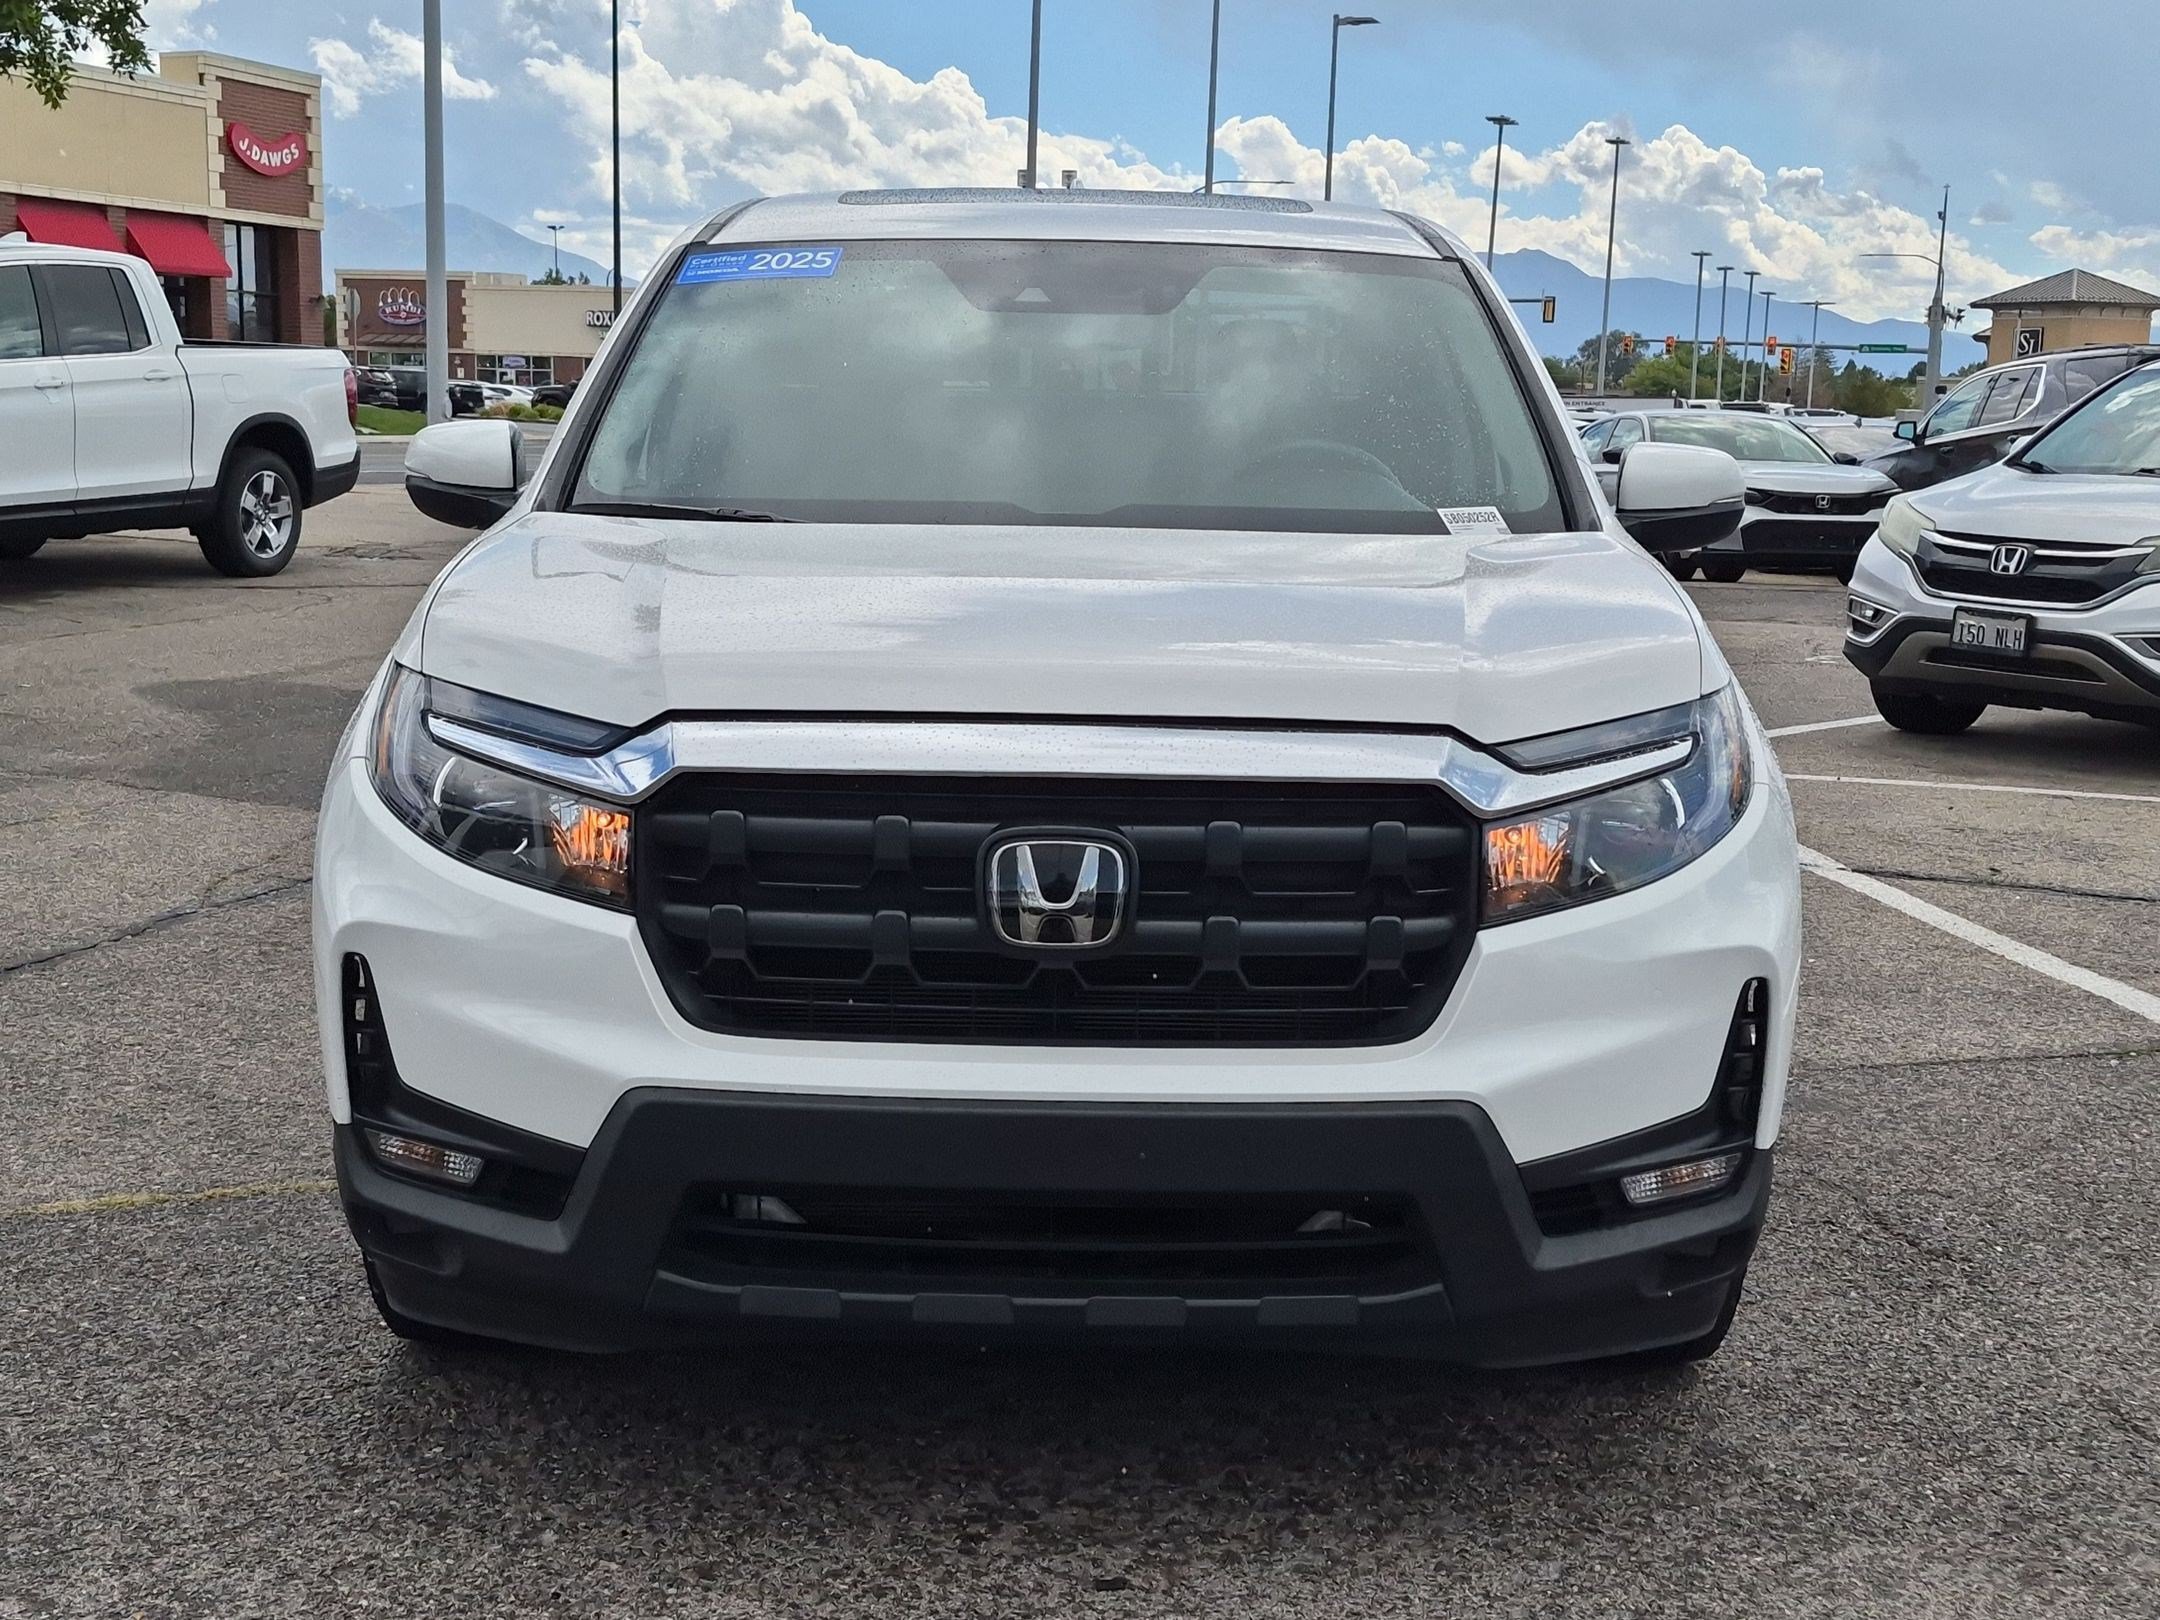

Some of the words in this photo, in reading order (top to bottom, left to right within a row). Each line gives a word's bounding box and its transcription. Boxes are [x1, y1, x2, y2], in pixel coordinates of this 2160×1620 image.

[239, 138, 299, 167] J.DAWGS
[692, 254, 747, 265] Certified
[748, 252, 835, 270] 2025
[1995, 626, 2023, 650] NLH
